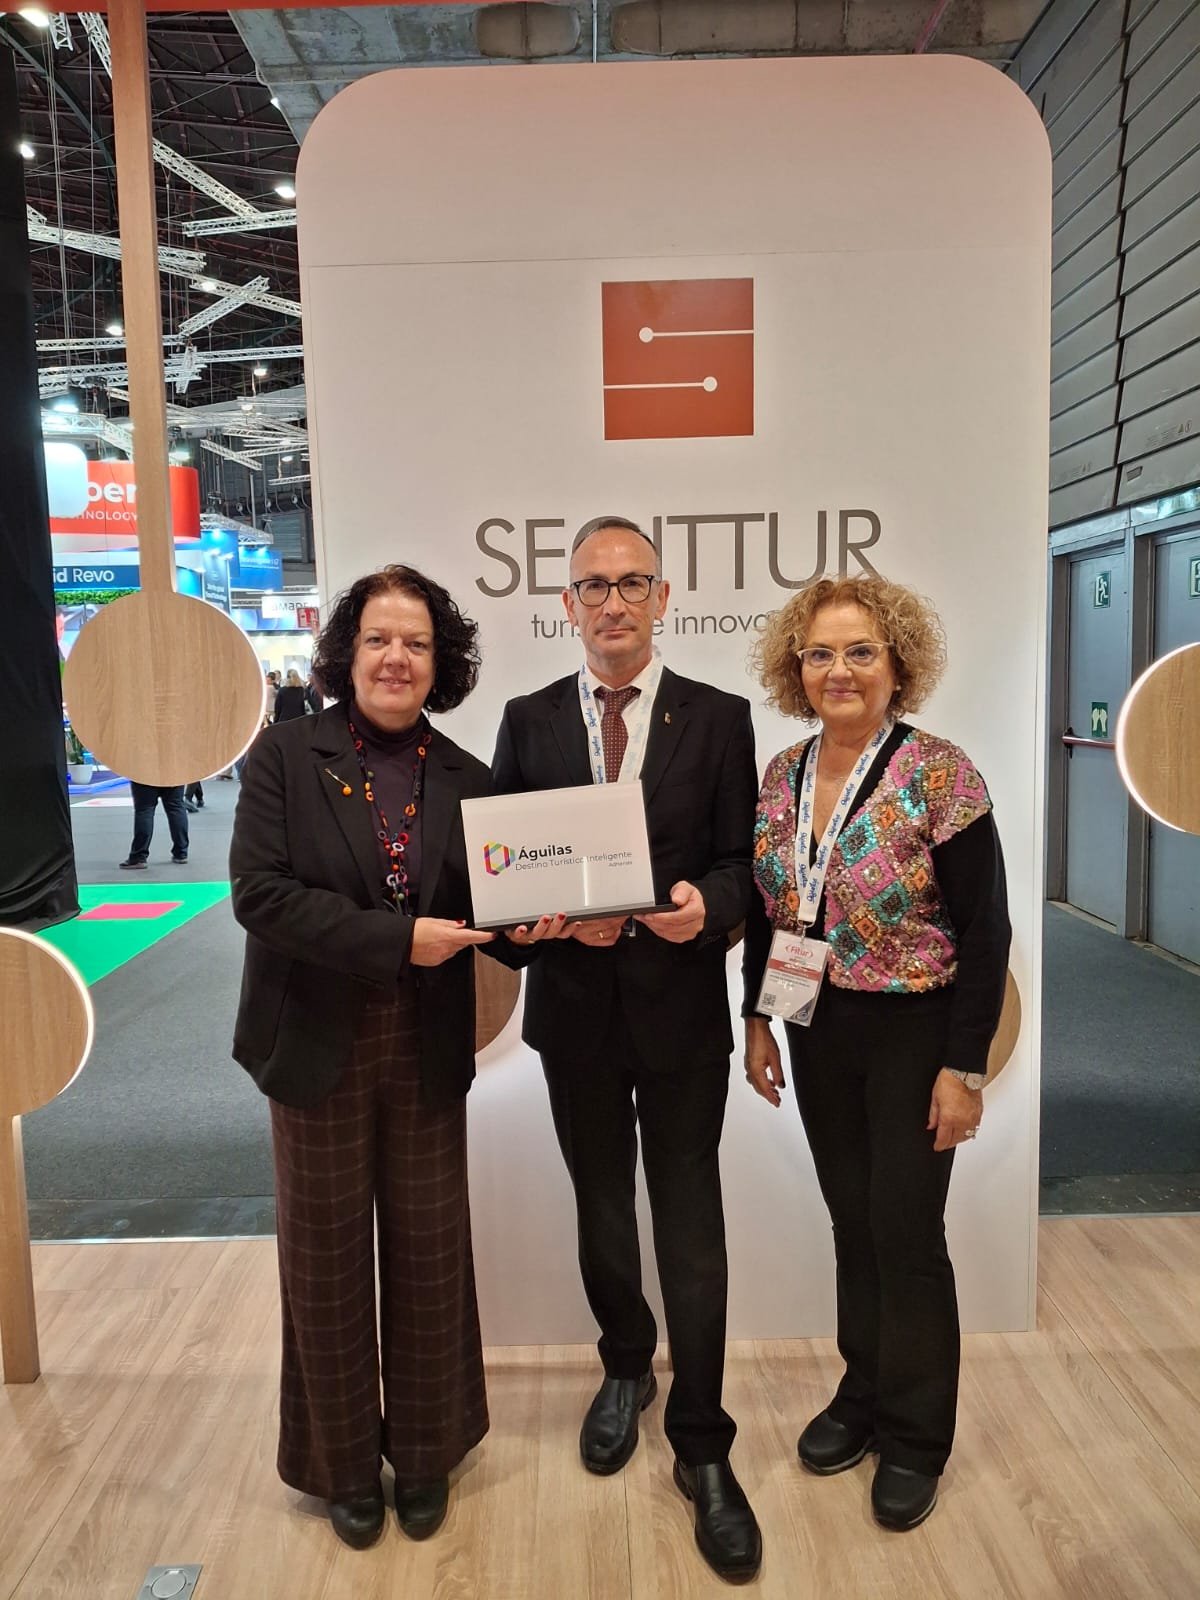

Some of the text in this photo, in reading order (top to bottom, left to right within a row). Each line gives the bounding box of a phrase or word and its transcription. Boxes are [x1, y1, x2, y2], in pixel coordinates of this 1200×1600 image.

[73, 568, 115, 583] Revo
[515, 851, 632, 871] Destino Turístico Inteligente
[518, 843, 573, 861] Águilas
